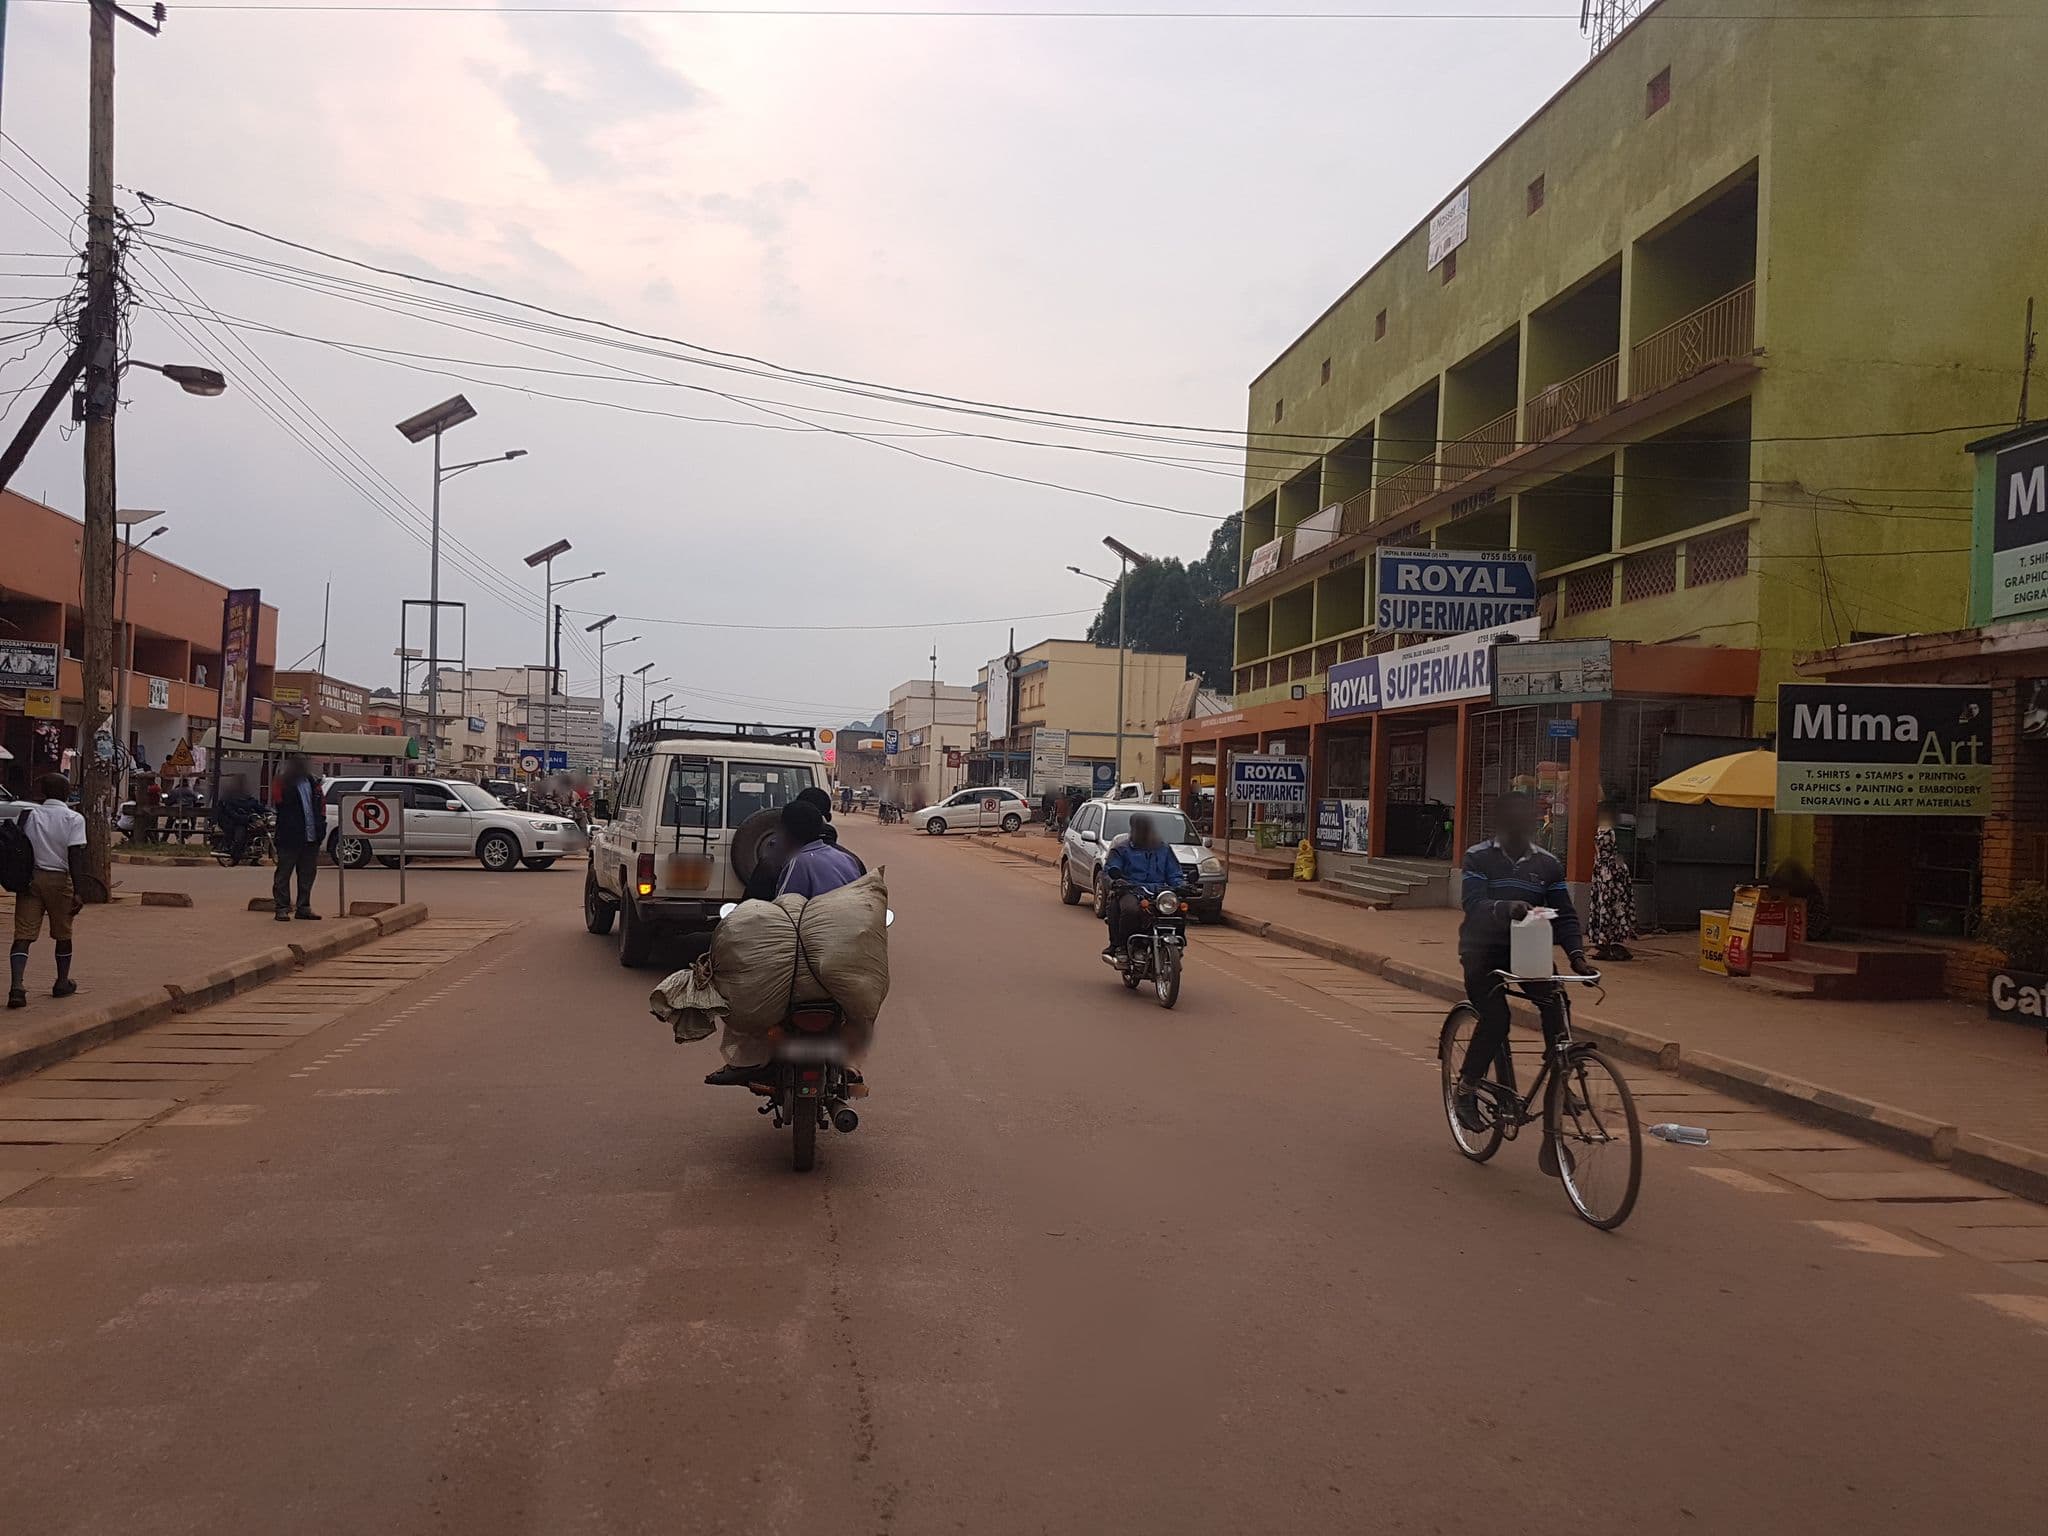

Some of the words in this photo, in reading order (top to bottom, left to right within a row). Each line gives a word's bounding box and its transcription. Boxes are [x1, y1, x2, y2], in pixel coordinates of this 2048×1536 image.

[1481, 552, 1500, 560] 0755
[1397, 563, 1516, 594] ROYAL
[2014, 589, 2048, 604] ENGRA
[1379, 599, 1535, 631] SUPERMARKET
[341, 689, 363, 704] TOURS
[1330, 674, 1377, 710] ROYAL
[325, 697, 346, 712] TRAVEL
[346, 702, 362, 716] HOTEL
[1792, 703, 1919, 742] Mima
[1917, 731, 1983, 765] Art
[1244, 765, 1296, 780] ROYAL
[1817, 770, 1850, 779] SHIRTS
[1865, 771, 1904, 780] STAMPS
[1919, 772, 1966, 781] PRINTING
[1236, 783, 1304, 801] SUPERMARKET
[1790, 783, 1841, 793] GRAPHICS
[1856, 784, 1904, 793] PAINTING
[1919, 785, 1982, 794] EMBROIDERY
[1800, 797, 1861, 806] ENGRAVING
[1873, 798, 1891, 807] ALL
[1894, 798, 1915, 807] ART
[1916, 798, 1972, 808] MATERIALS
[1319, 812, 1340, 827] ROYAL
[1316, 827, 1343, 841] SUPERMARKET
